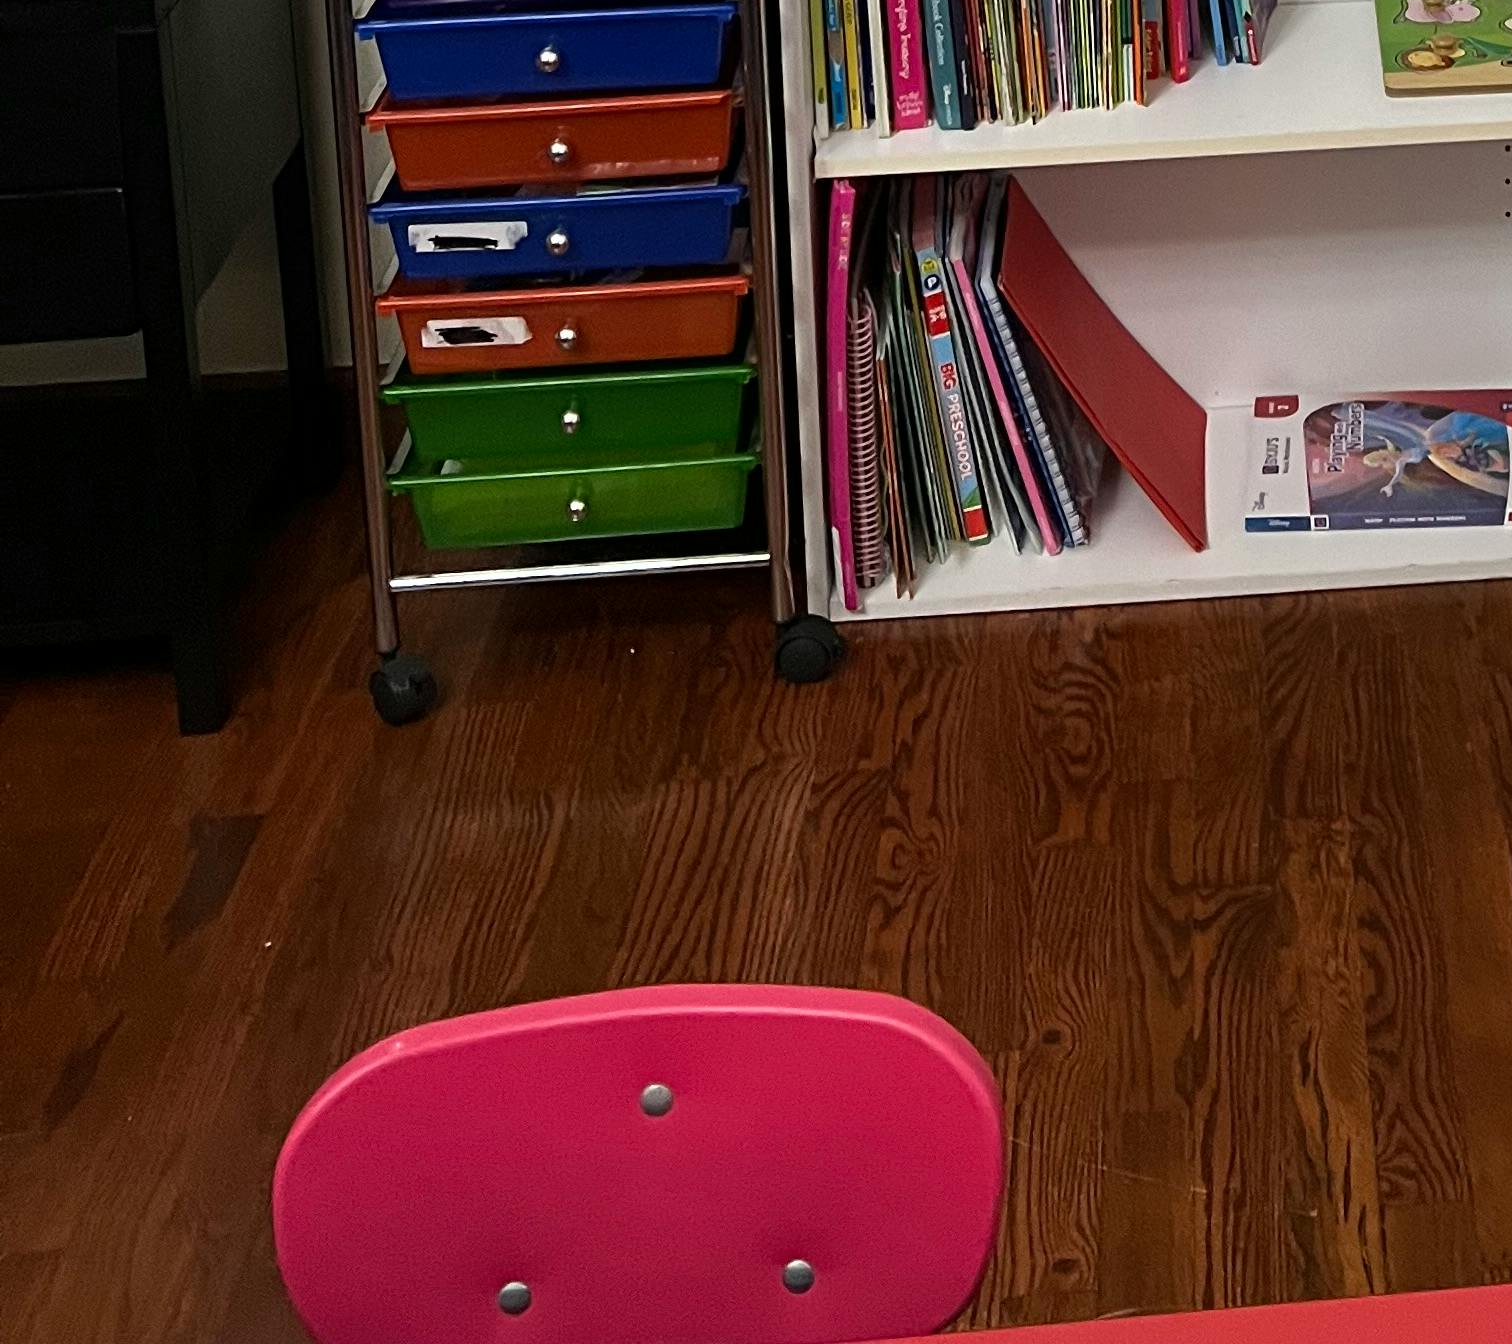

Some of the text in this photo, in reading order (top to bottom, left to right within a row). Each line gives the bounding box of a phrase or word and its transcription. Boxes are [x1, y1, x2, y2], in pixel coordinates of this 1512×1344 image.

[939, 362, 973, 481] BIG PRESCHOOL
[1349, 403, 1365, 450] Numbers
[1328, 430, 1346, 473] Playing
